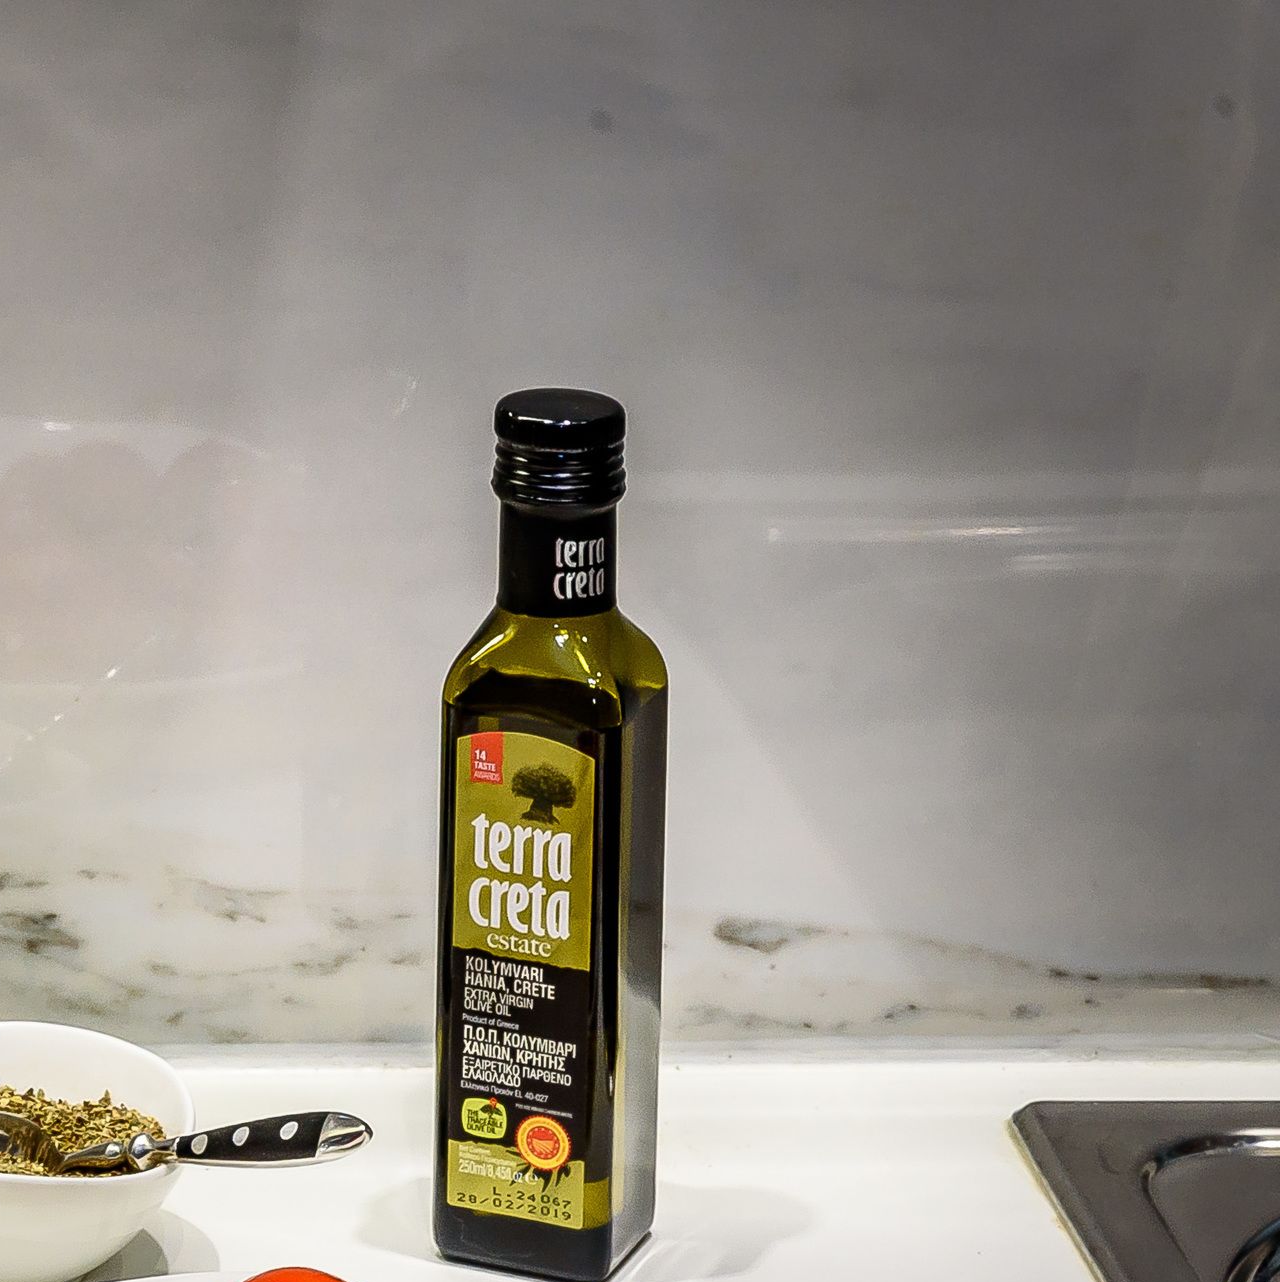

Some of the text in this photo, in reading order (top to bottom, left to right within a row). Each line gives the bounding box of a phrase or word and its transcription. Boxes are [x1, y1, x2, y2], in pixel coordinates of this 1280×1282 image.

[556, 537, 604, 567] terra
[553, 567, 604, 600] creta
[474, 761, 496, 772] TASTE
[475, 749, 486, 761] 14
[471, 812, 572, 883] terra
[468, 876, 571, 940] creta
[486, 932, 552, 958] estate
[465, 955, 544, 983] KOLYMVARI
[464, 986, 534, 1010] EXTRA VIRGIN
[465, 970, 556, 1000] HANIA, CRETE
[462, 1013, 488, 1025] Product
[464, 996, 512, 1017] OLIVE OIL
[463, 1039, 566, 1072] ΧΑΝΙΩΝ, ΚΡΗΤΗΣ
[503, 1031, 577, 1059] ΚΟΛΥΜΒΑΡΙ
[462, 1056, 572, 1086] ΕΞΑΙΡΕΤΙΚΟ ΠΑΡΘΕΝΟ
[462, 1065, 521, 1088] ΕΛΑΙΟΛΑΔΟ
[457, 1192, 572, 1220] 28/02/2019
